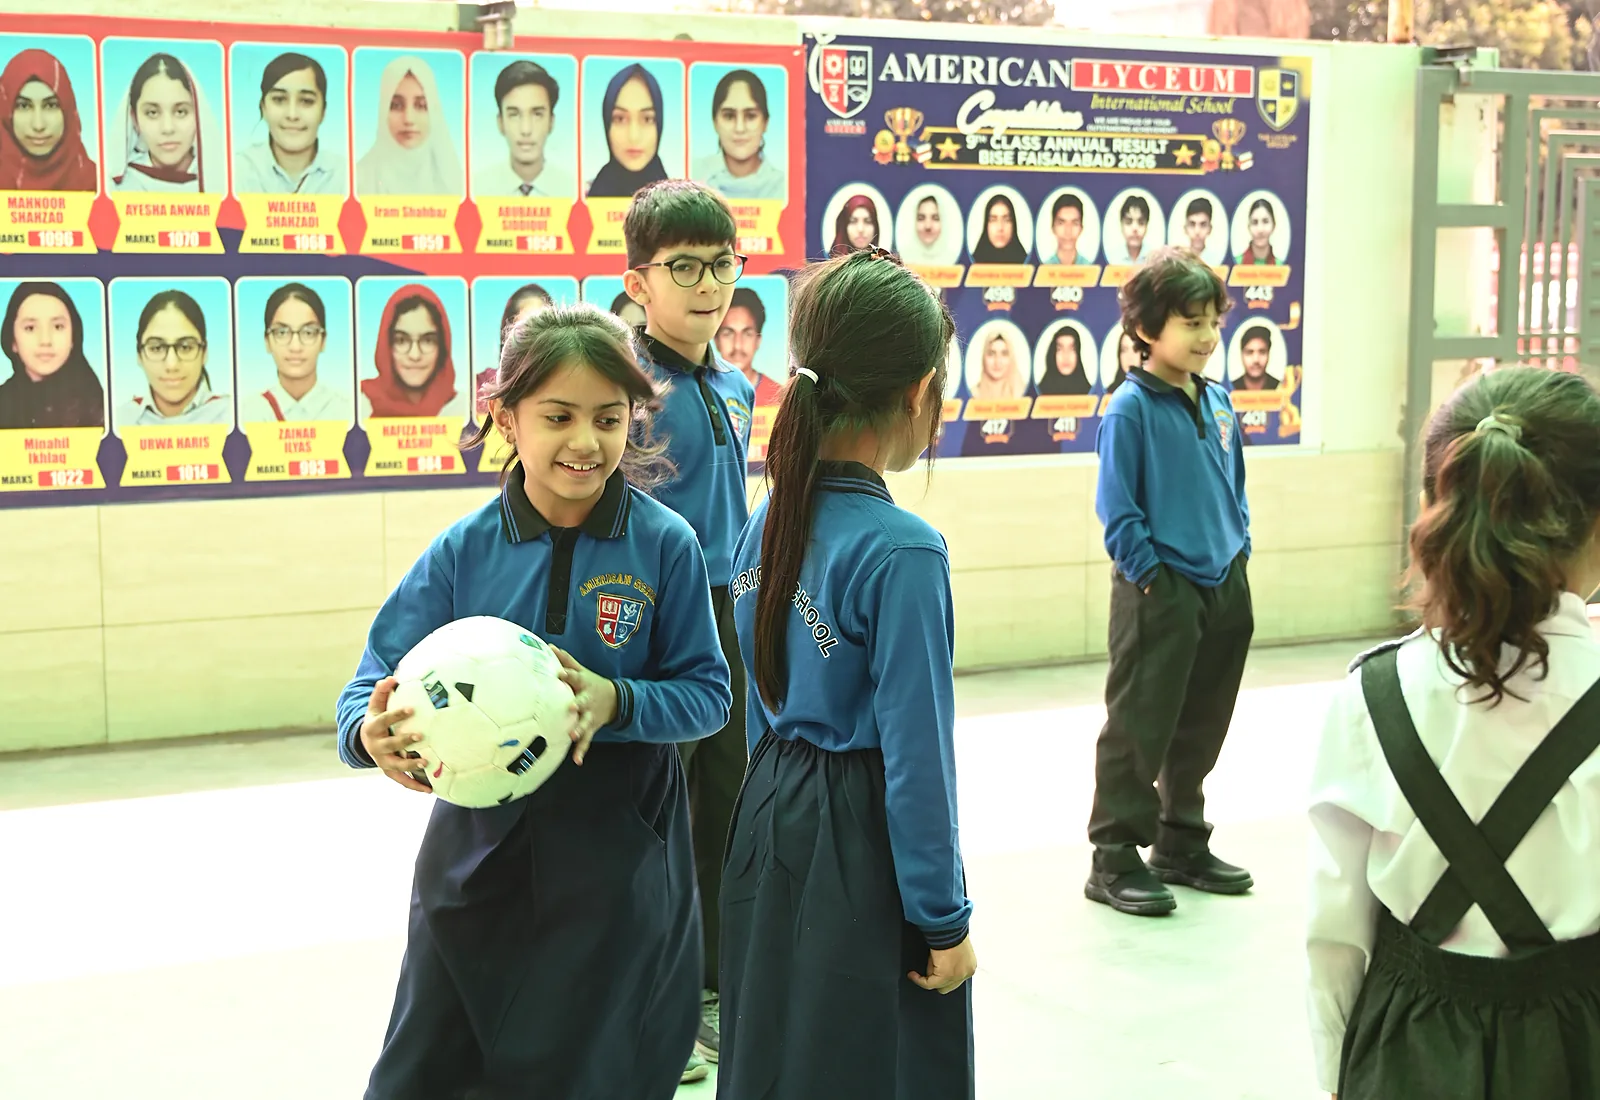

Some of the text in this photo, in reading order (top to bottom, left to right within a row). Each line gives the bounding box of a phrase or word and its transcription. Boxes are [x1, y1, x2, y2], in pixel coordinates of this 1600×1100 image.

[878, 52, 1237, 93] AMERICAN LYCEUM
[1090, 92, 1236, 114] International School
[990, 136, 1042, 151] CLASS
[1044, 137, 1110, 153] ANNUAL
[1112, 139, 1170, 154] RESULT
[978, 150, 1157, 168] BISE FAISALABAD 2026
[7, 197, 66, 209] MAHNOOR
[267, 201, 317, 213] WAJEEHA
[125, 204, 211, 217] AYESHA ANWAR
[374, 206, 447, 218] Iram Shahbaz
[11, 211, 64, 224] SHAHZAD
[266, 216, 319, 228] SHAHZADI
[0, 230, 75, 248] ARKS 1096
[125, 231, 201, 248] MARKS 1070
[250, 238, 280, 247] MARKS
[371, 238, 400, 247] MARKS
[486, 239, 514, 248] MARKS
[981, 418, 1009, 435] 417
[1053, 416, 1077, 432] 411
[278, 427, 317, 440] ZAINAB
[382, 425, 418, 437] HAFIZA
[24, 437, 70, 451] Minahil
[139, 436, 210, 451] URWA HARIS
[283, 441, 312, 453] ILYAS
[28, 452, 67, 465] Ikhlaq
[375, 460, 403, 470] MARKS
[131, 464, 209, 481] MARKS 1014
[256, 465, 285, 474] MARKS
[1, 469, 84, 486] MARKS 1022
[579, 573, 633, 597] AMERICAN
